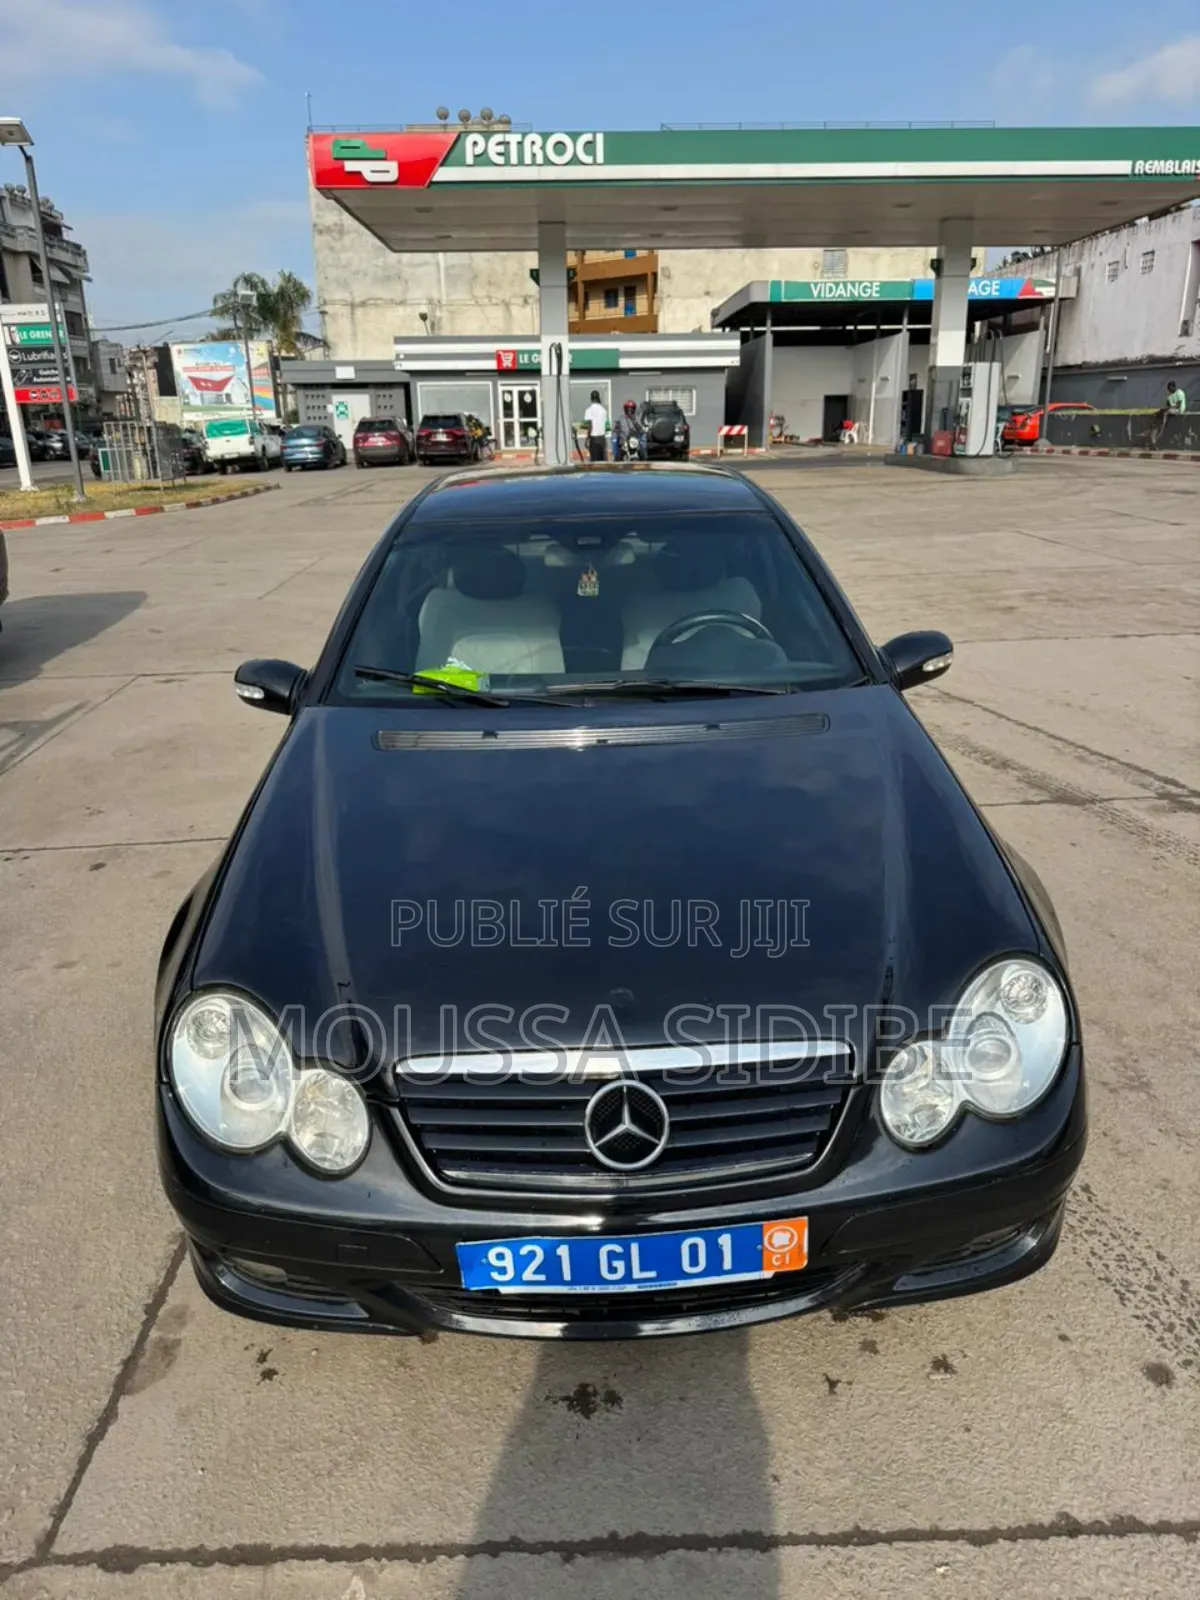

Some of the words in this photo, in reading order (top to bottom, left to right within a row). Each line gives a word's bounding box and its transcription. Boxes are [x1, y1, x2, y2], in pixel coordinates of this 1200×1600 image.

[465, 132, 604, 166] PETROCI
[810, 281, 880, 298] VIDANGE
[968, 279, 1001, 296] AGE
[22, 351, 68, 361] Lubrifias
[519, 353, 530, 364] LE
[487, 1244, 572, 1282] 921
[600, 1242, 657, 1281] GL
[681, 1233, 733, 1275] 01
[772, 1252, 790, 1266] CI
